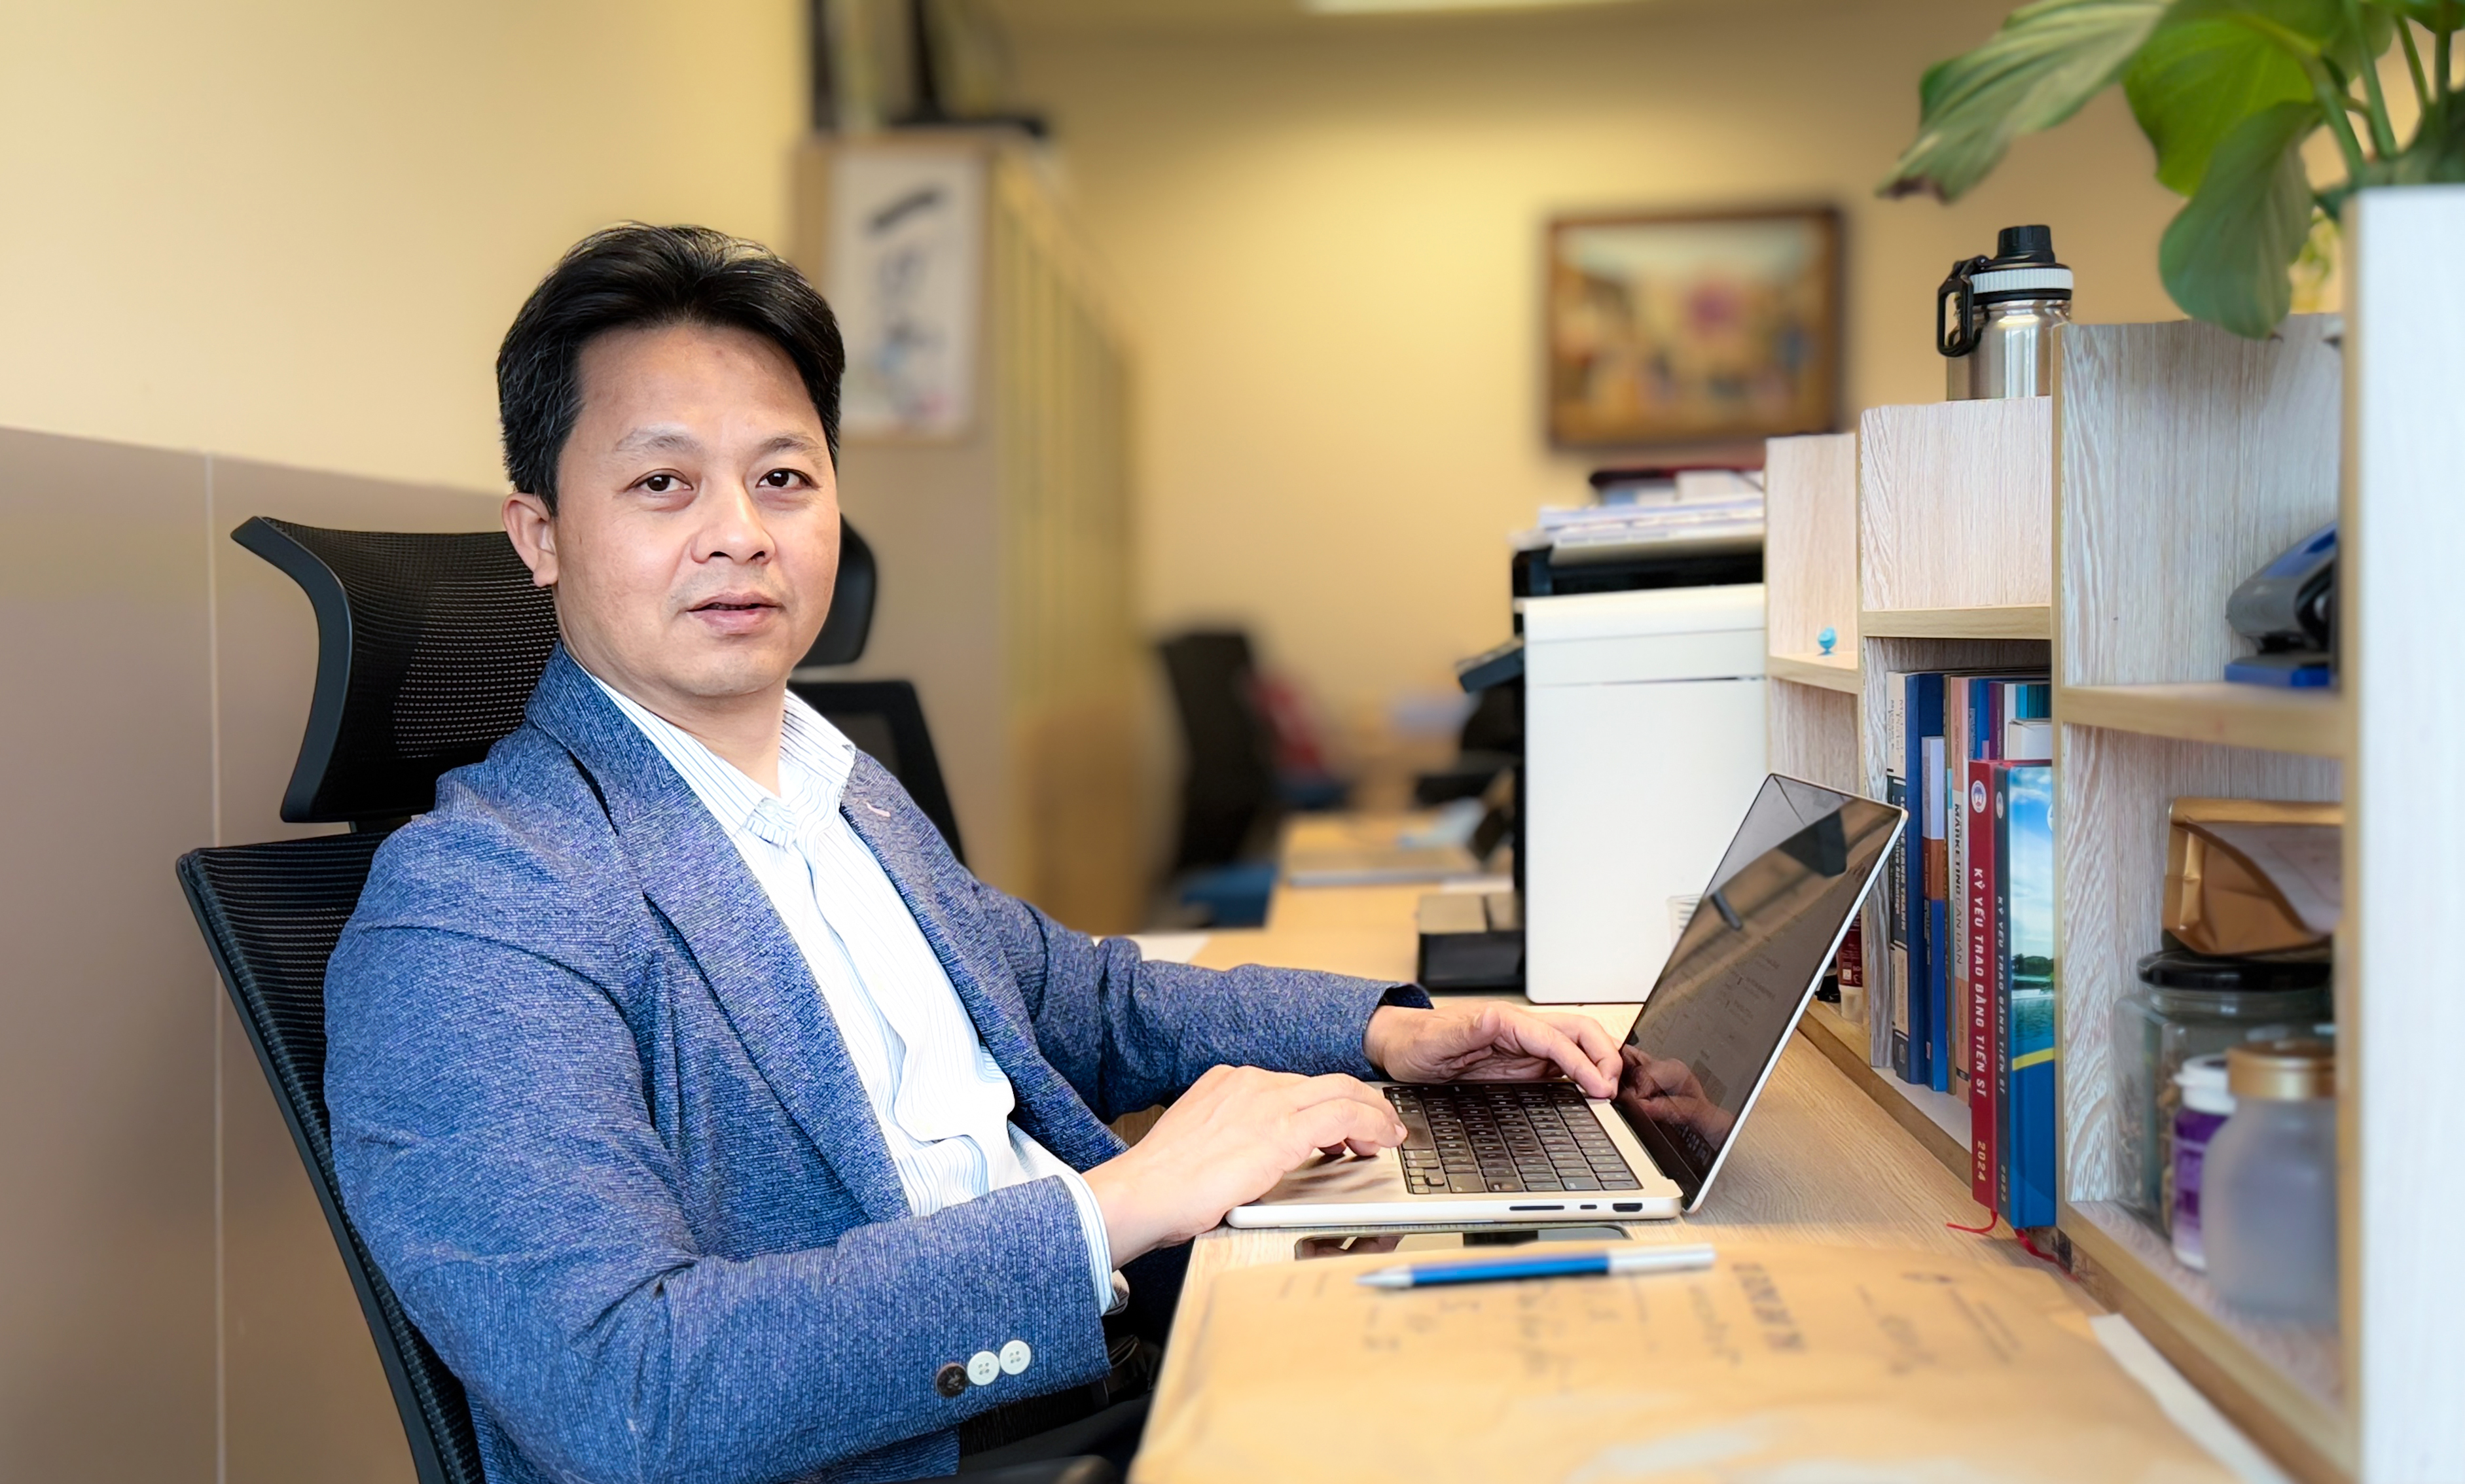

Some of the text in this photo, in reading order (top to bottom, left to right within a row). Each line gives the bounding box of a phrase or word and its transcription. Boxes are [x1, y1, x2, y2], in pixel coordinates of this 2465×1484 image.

[1974, 897, 1986, 928] YẾU
[1974, 935, 1984, 977] TRAO
[1975, 983, 1987, 1028] BẰNG
[1975, 1034, 1987, 1072] TIẾN
[1977, 1140, 1986, 1181] 2024
